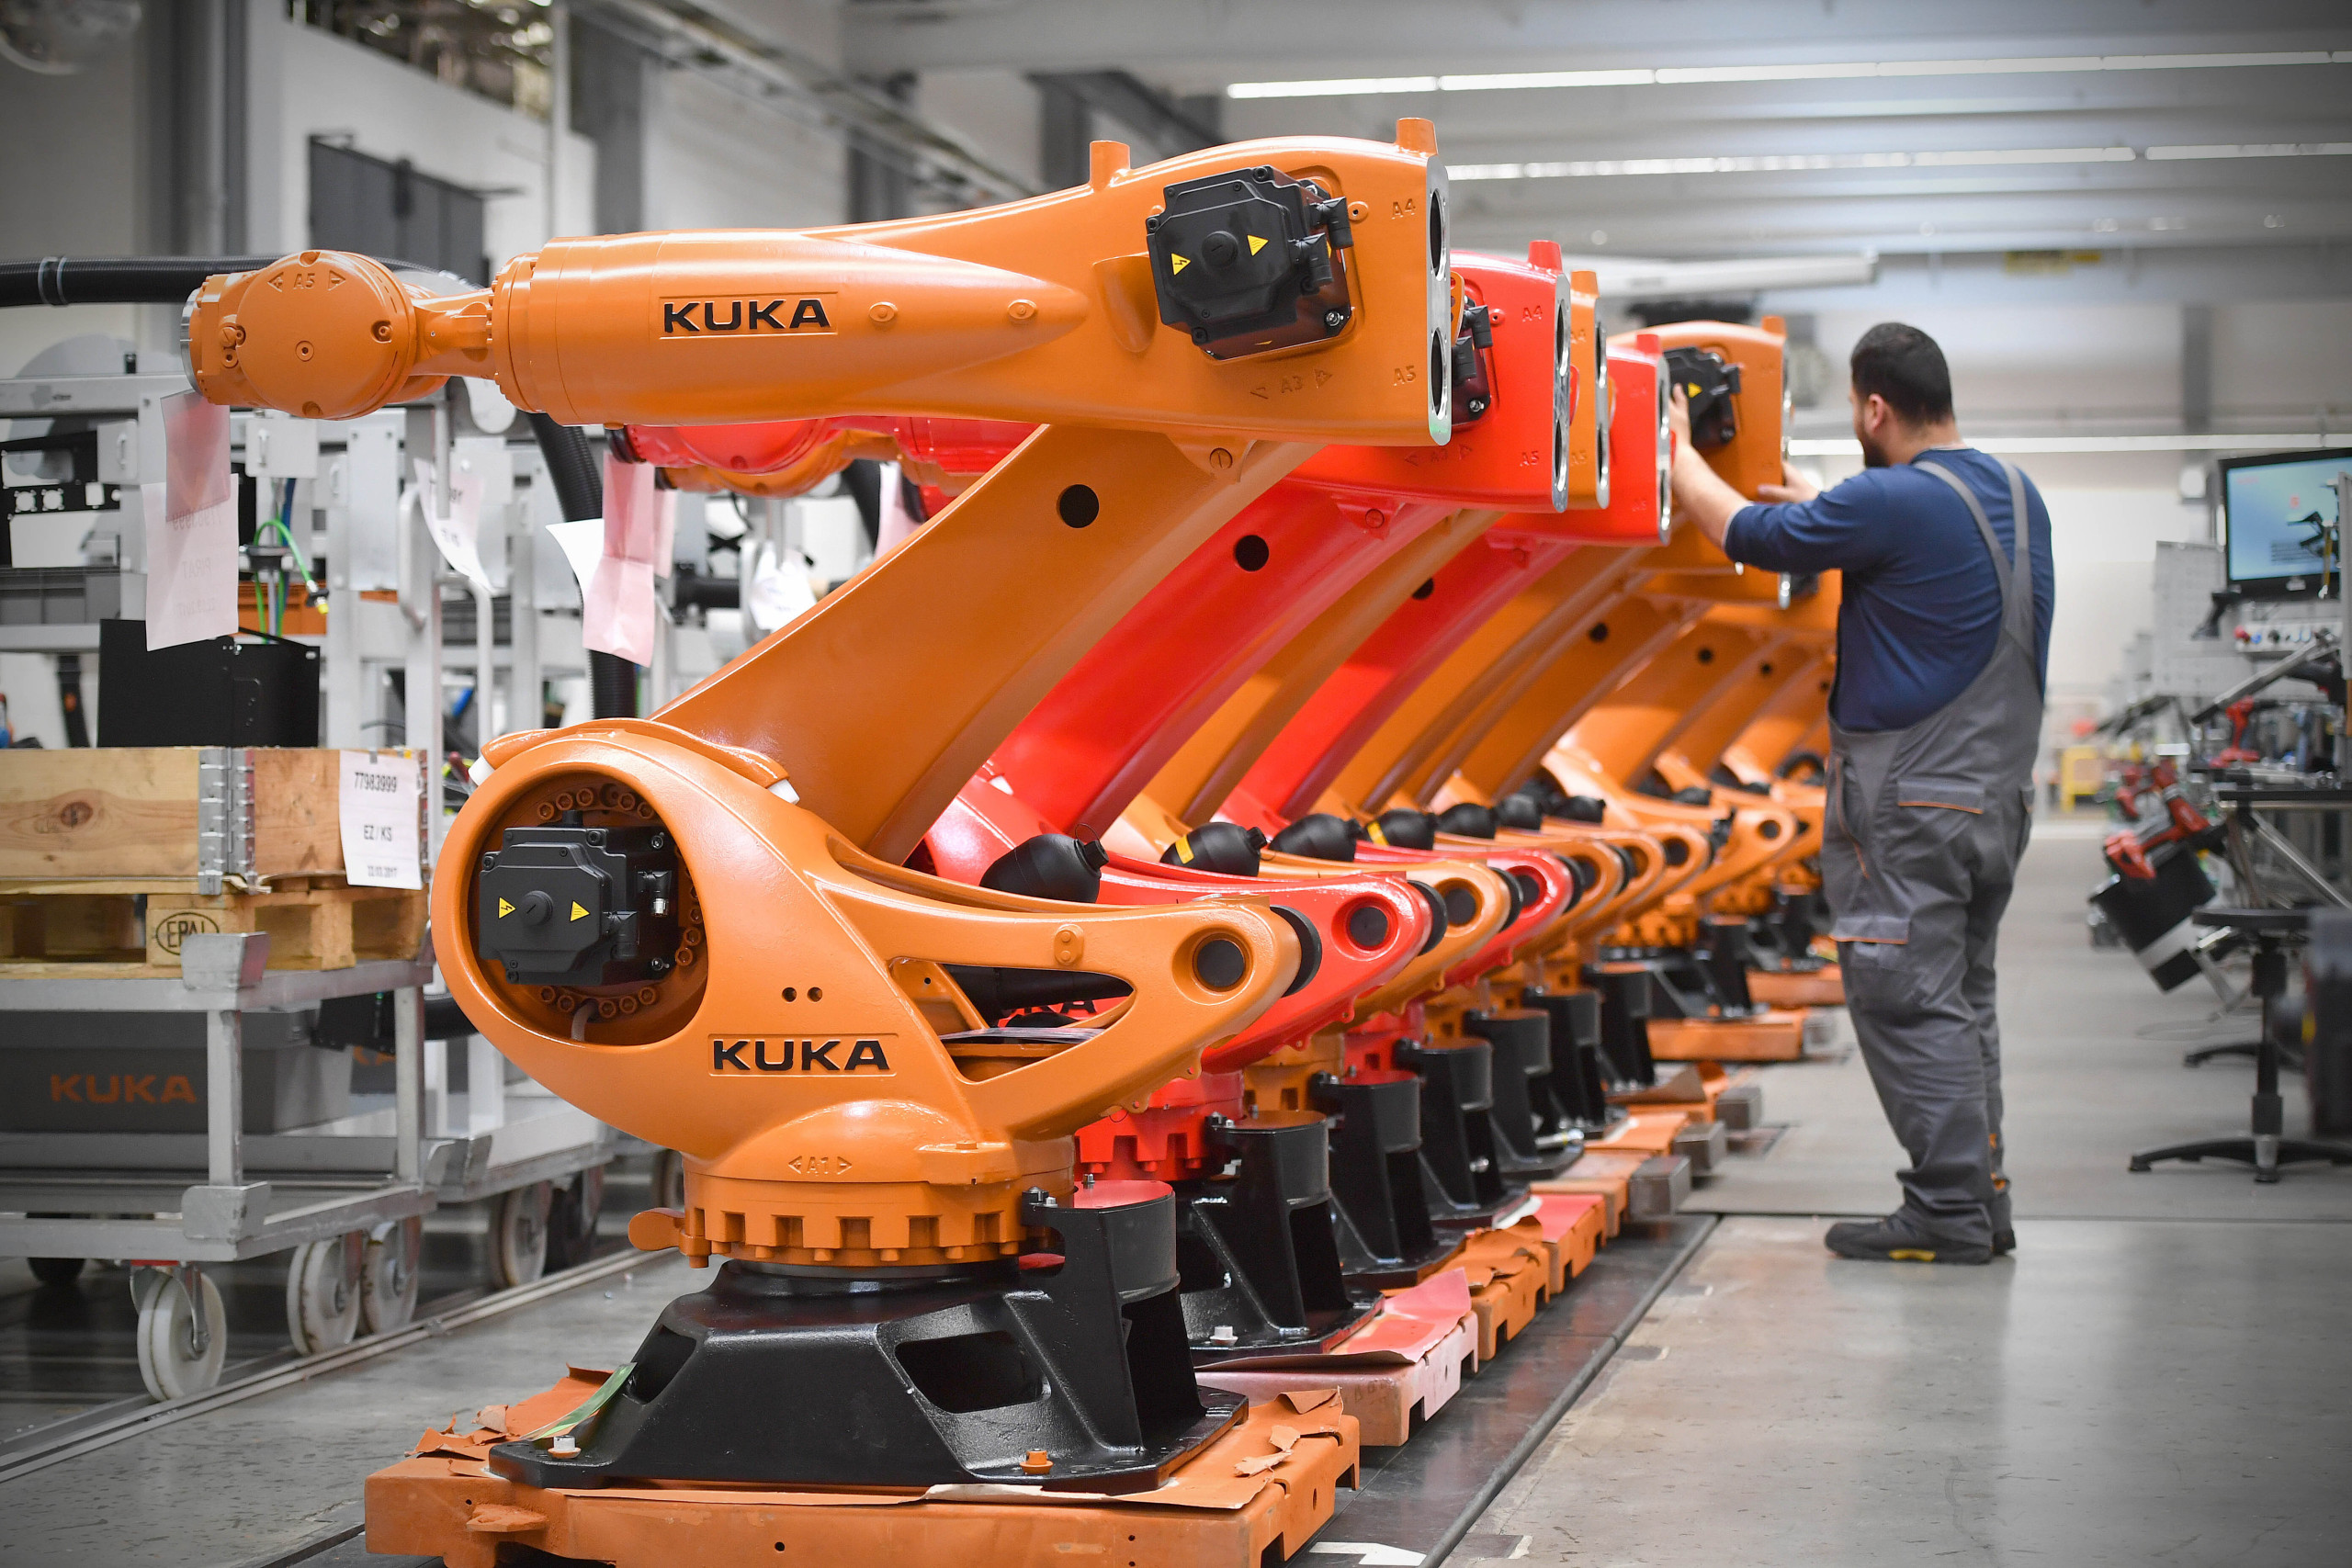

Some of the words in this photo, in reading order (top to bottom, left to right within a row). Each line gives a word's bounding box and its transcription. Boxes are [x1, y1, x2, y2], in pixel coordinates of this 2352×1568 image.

[1391, 198, 1416, 220] A4
[293, 273, 315, 289] A5
[664, 299, 831, 333] KUKA
[1522, 305, 1543, 322] A4
[1281, 376, 1303, 393] A3
[1393, 365, 1418, 386] A5
[1520, 450, 1539, 467] A5
[355, 772, 397, 793] 77983999
[713, 1039, 890, 1071] KUKA
[51, 1074, 197, 1102] KUKA
[807, 1156, 829, 1175] A1
